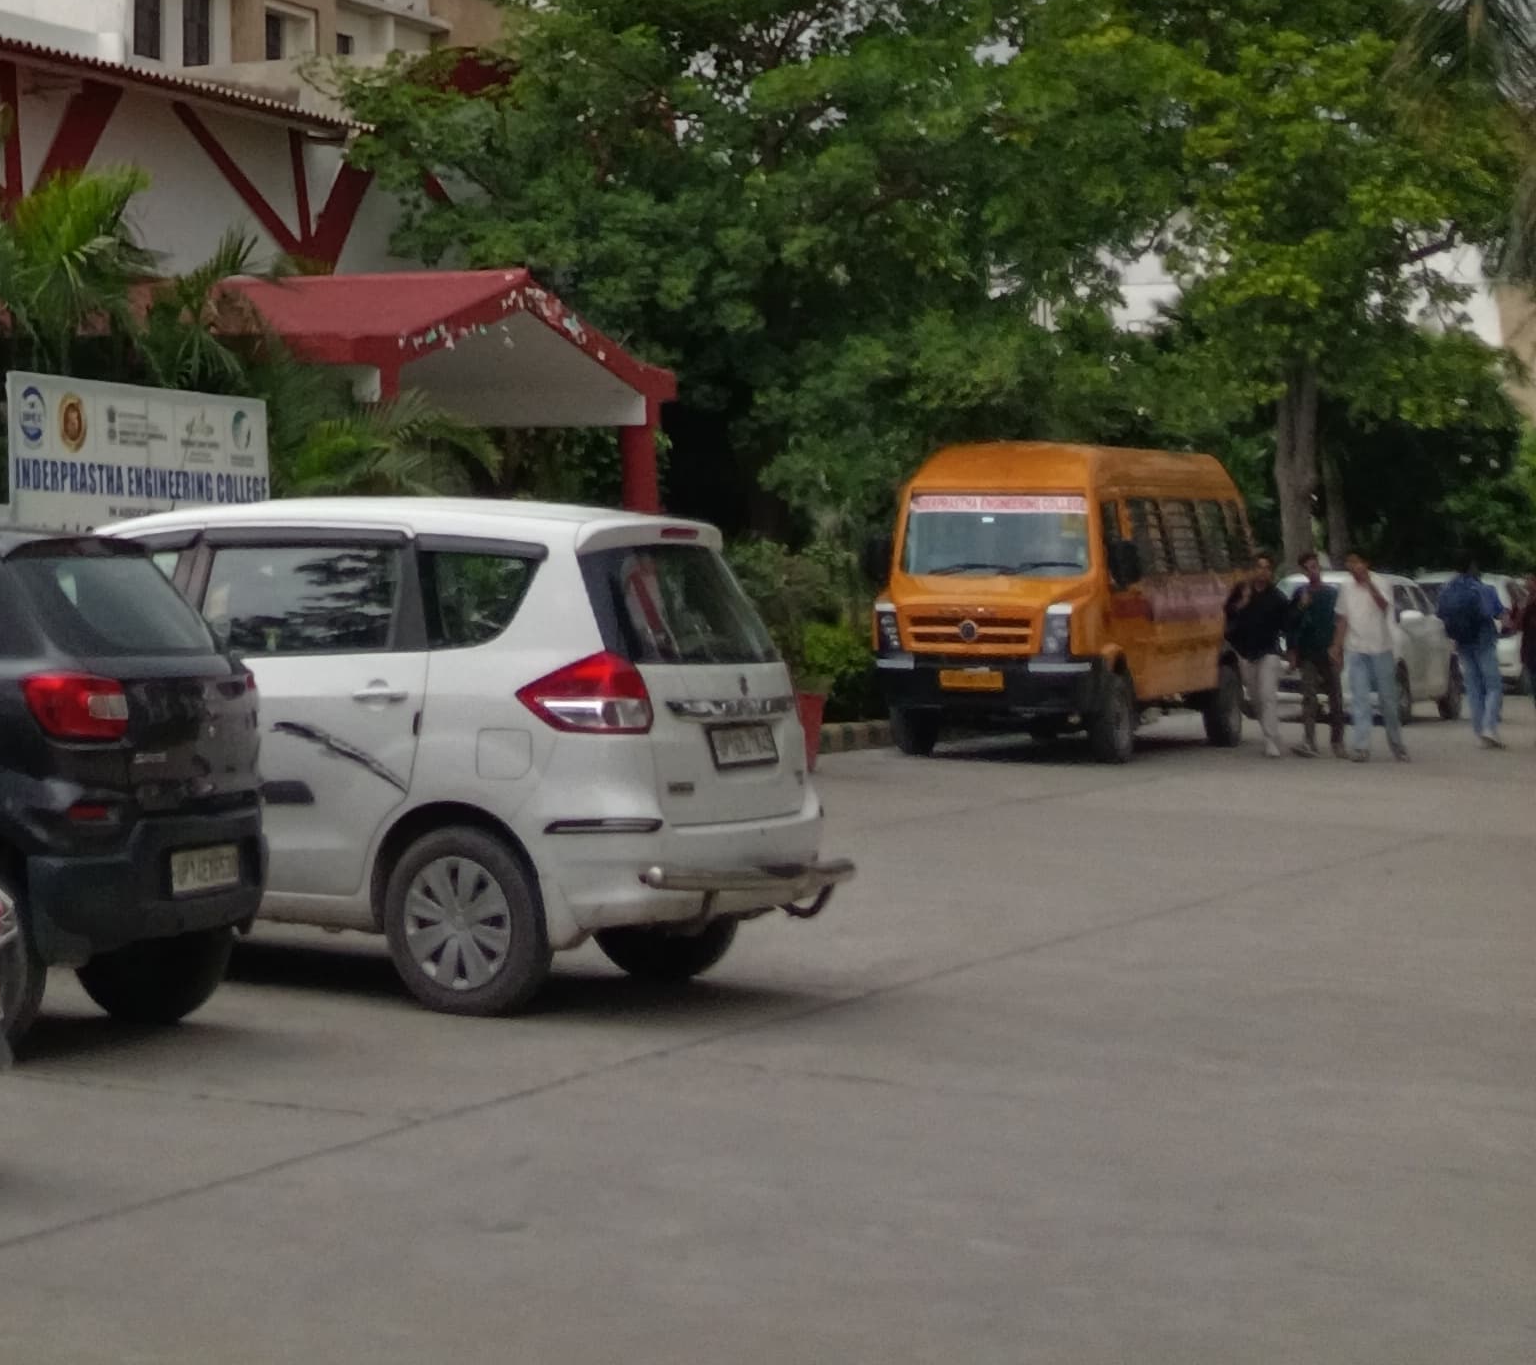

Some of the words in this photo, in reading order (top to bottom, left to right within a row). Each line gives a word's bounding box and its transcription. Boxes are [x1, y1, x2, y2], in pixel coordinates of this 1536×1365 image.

[15, 457, 125, 497] INDERPRASTHA
[127, 465, 214, 502] ENGINEERING
[216, 472, 268, 504] COLLEGE
